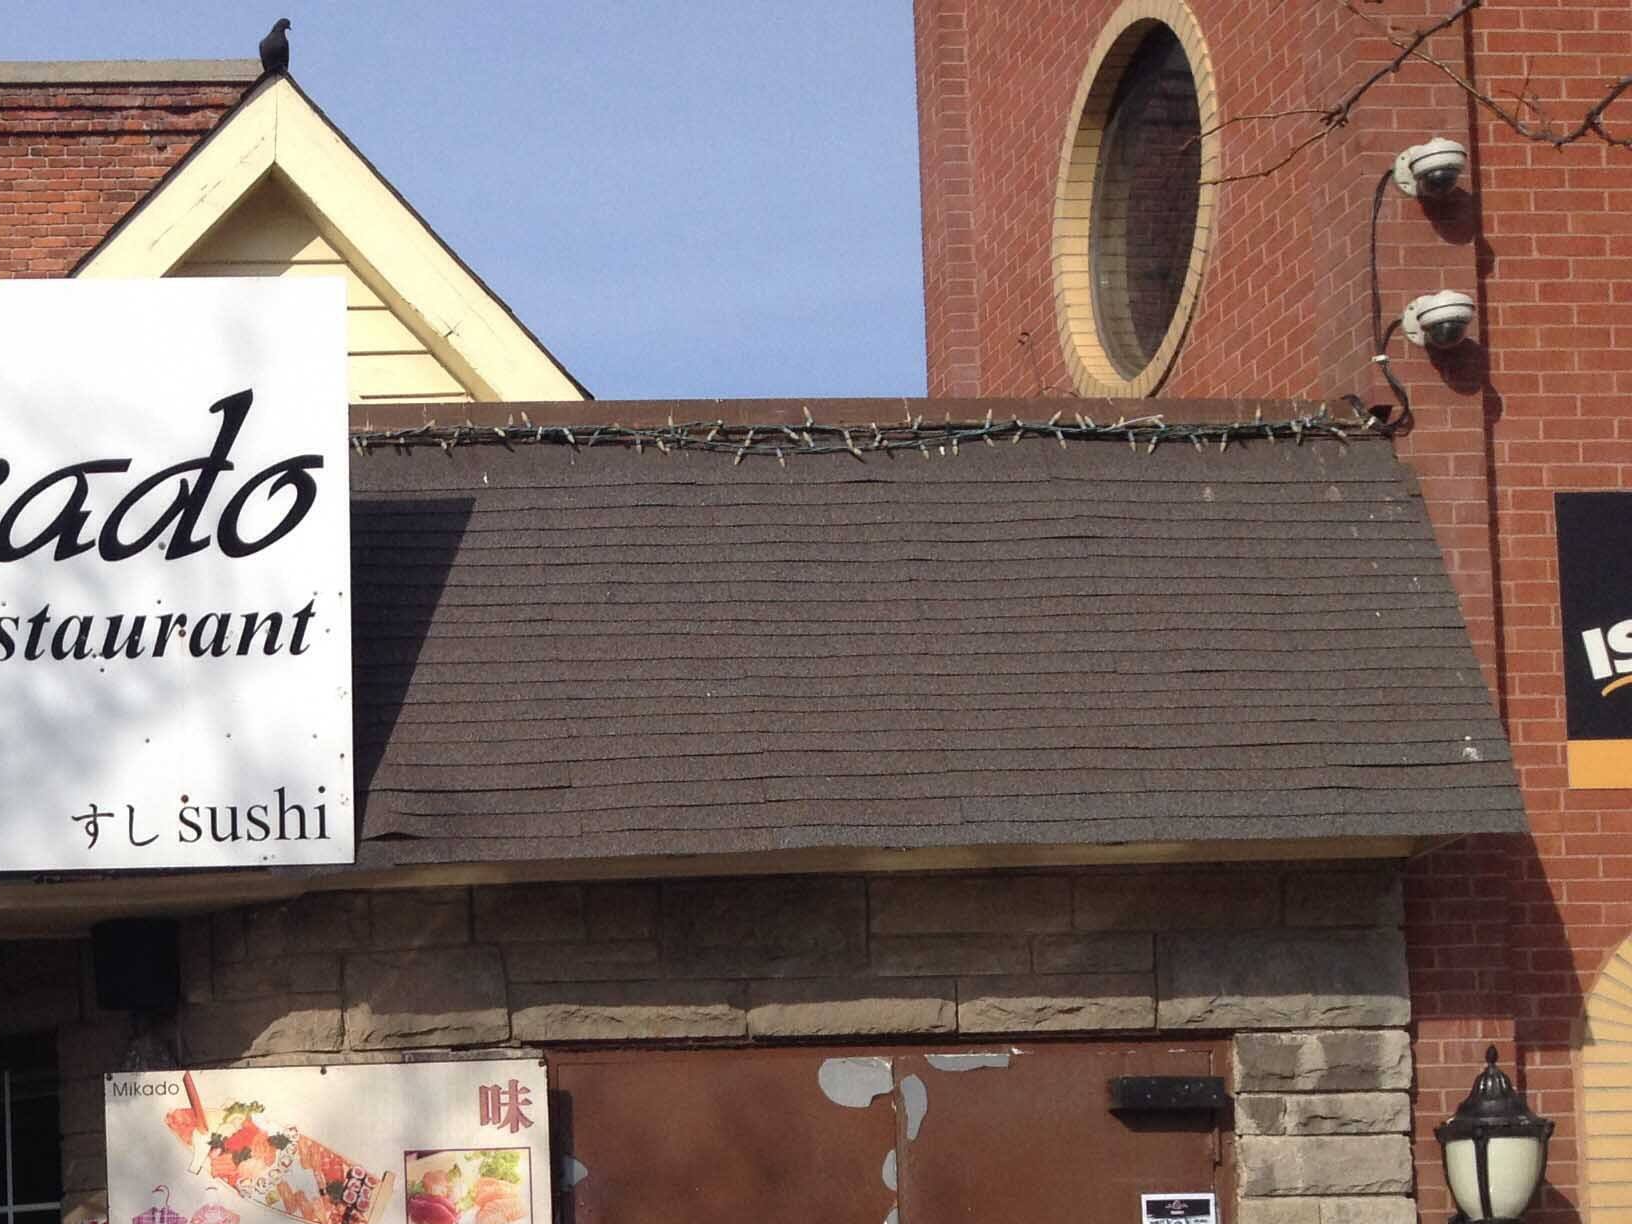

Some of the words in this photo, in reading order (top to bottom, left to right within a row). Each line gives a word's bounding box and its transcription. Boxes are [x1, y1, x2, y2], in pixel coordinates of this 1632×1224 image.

[71, 803, 160, 850] すし
[178, 785, 331, 843] sushi
[111, 1080, 181, 1098] Mikado
[477, 1078, 535, 1134] 味
